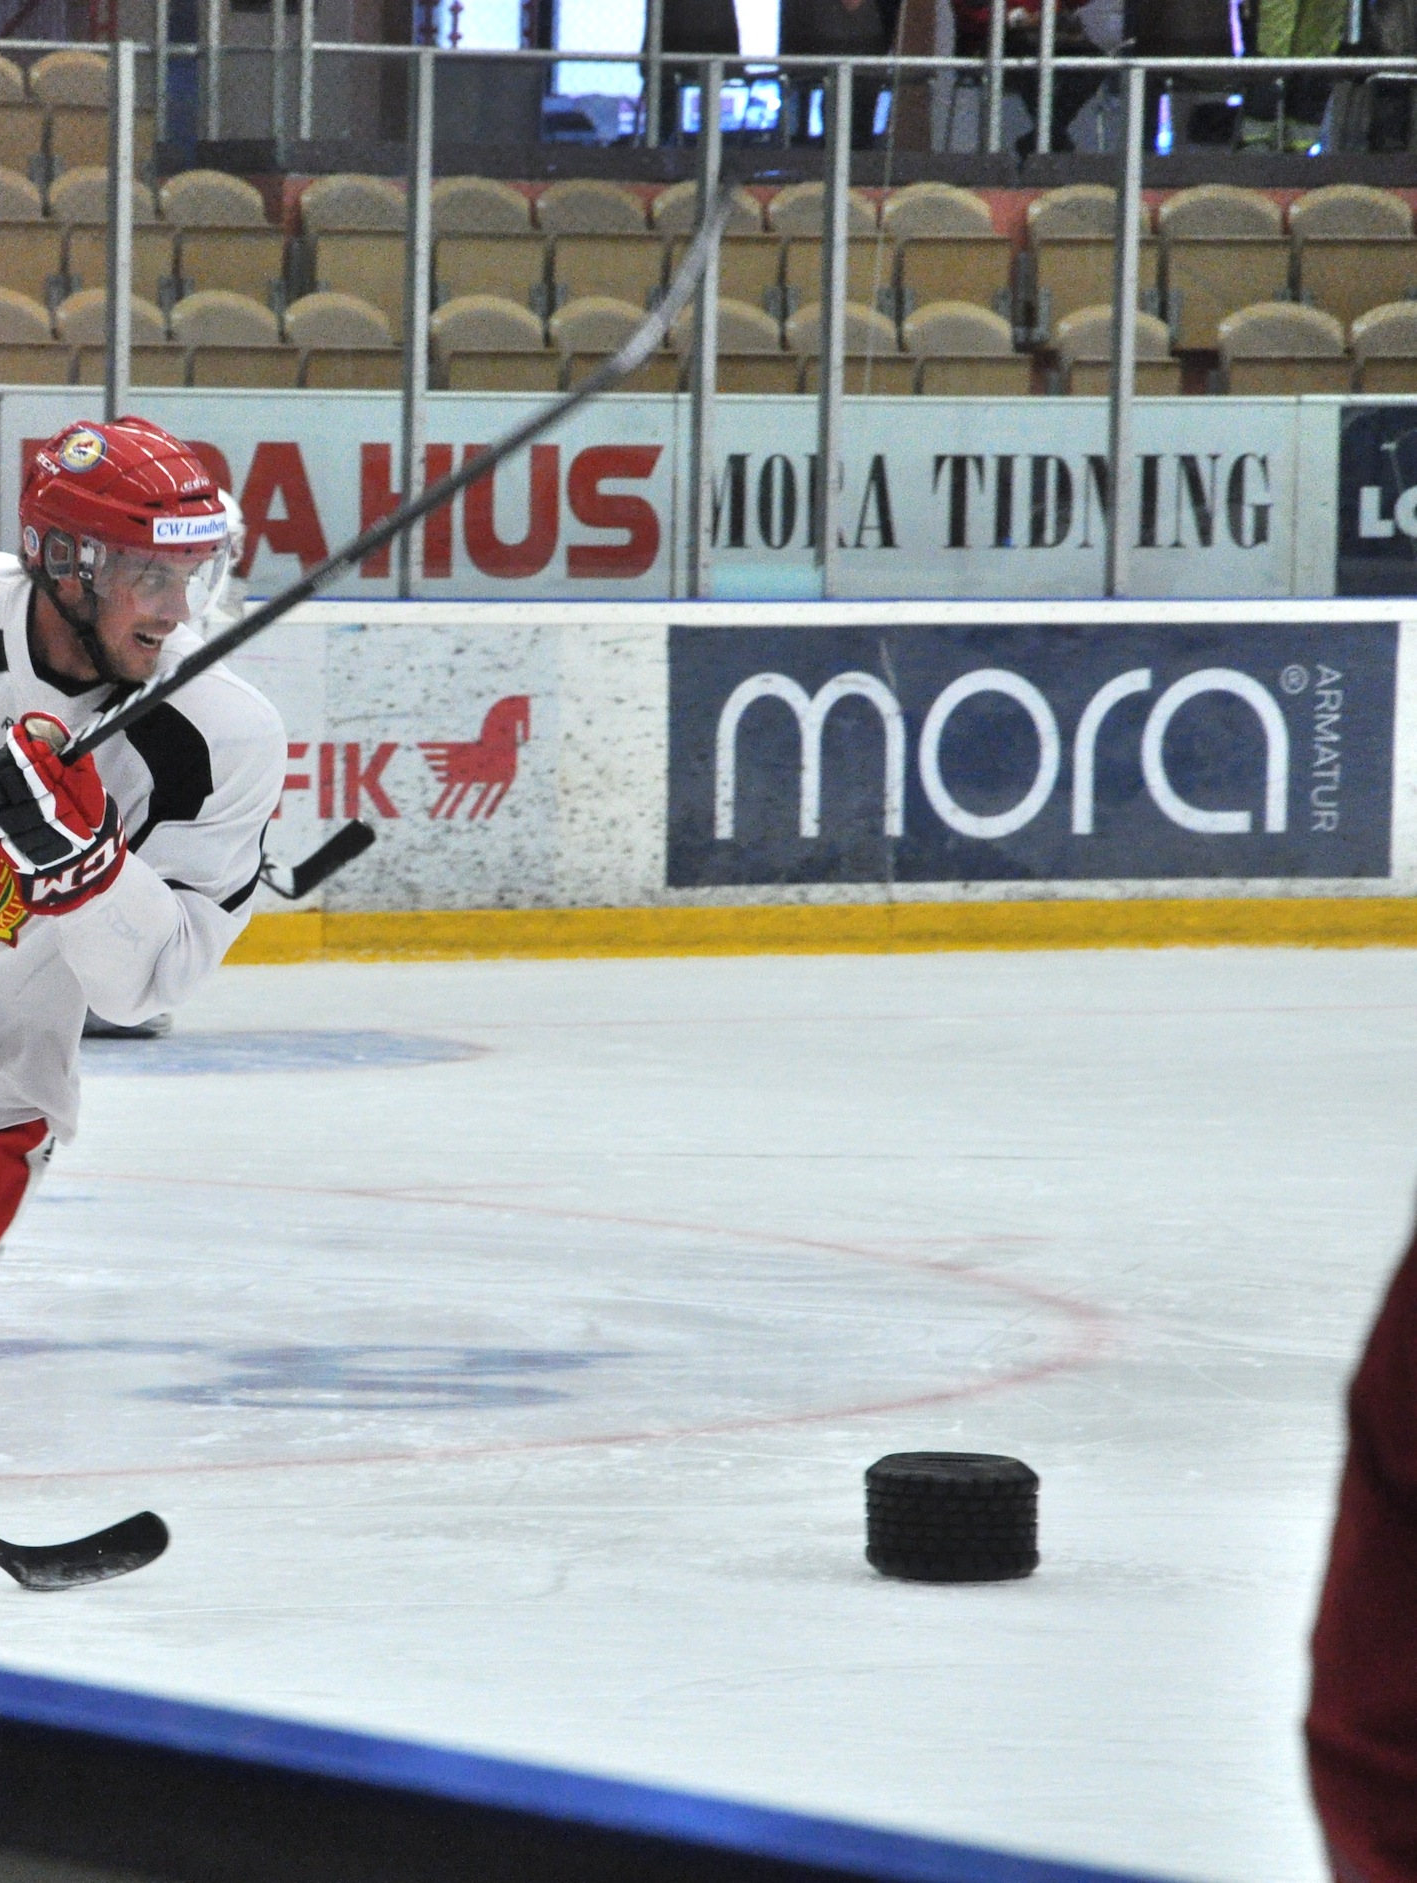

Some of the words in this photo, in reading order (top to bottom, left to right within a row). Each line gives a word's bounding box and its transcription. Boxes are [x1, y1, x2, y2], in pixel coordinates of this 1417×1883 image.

[157, 522, 183, 537] CW
[360, 443, 664, 580] HUS
[714, 668, 1289, 840] mora
[1311, 663, 1343, 834] ARMATUR
